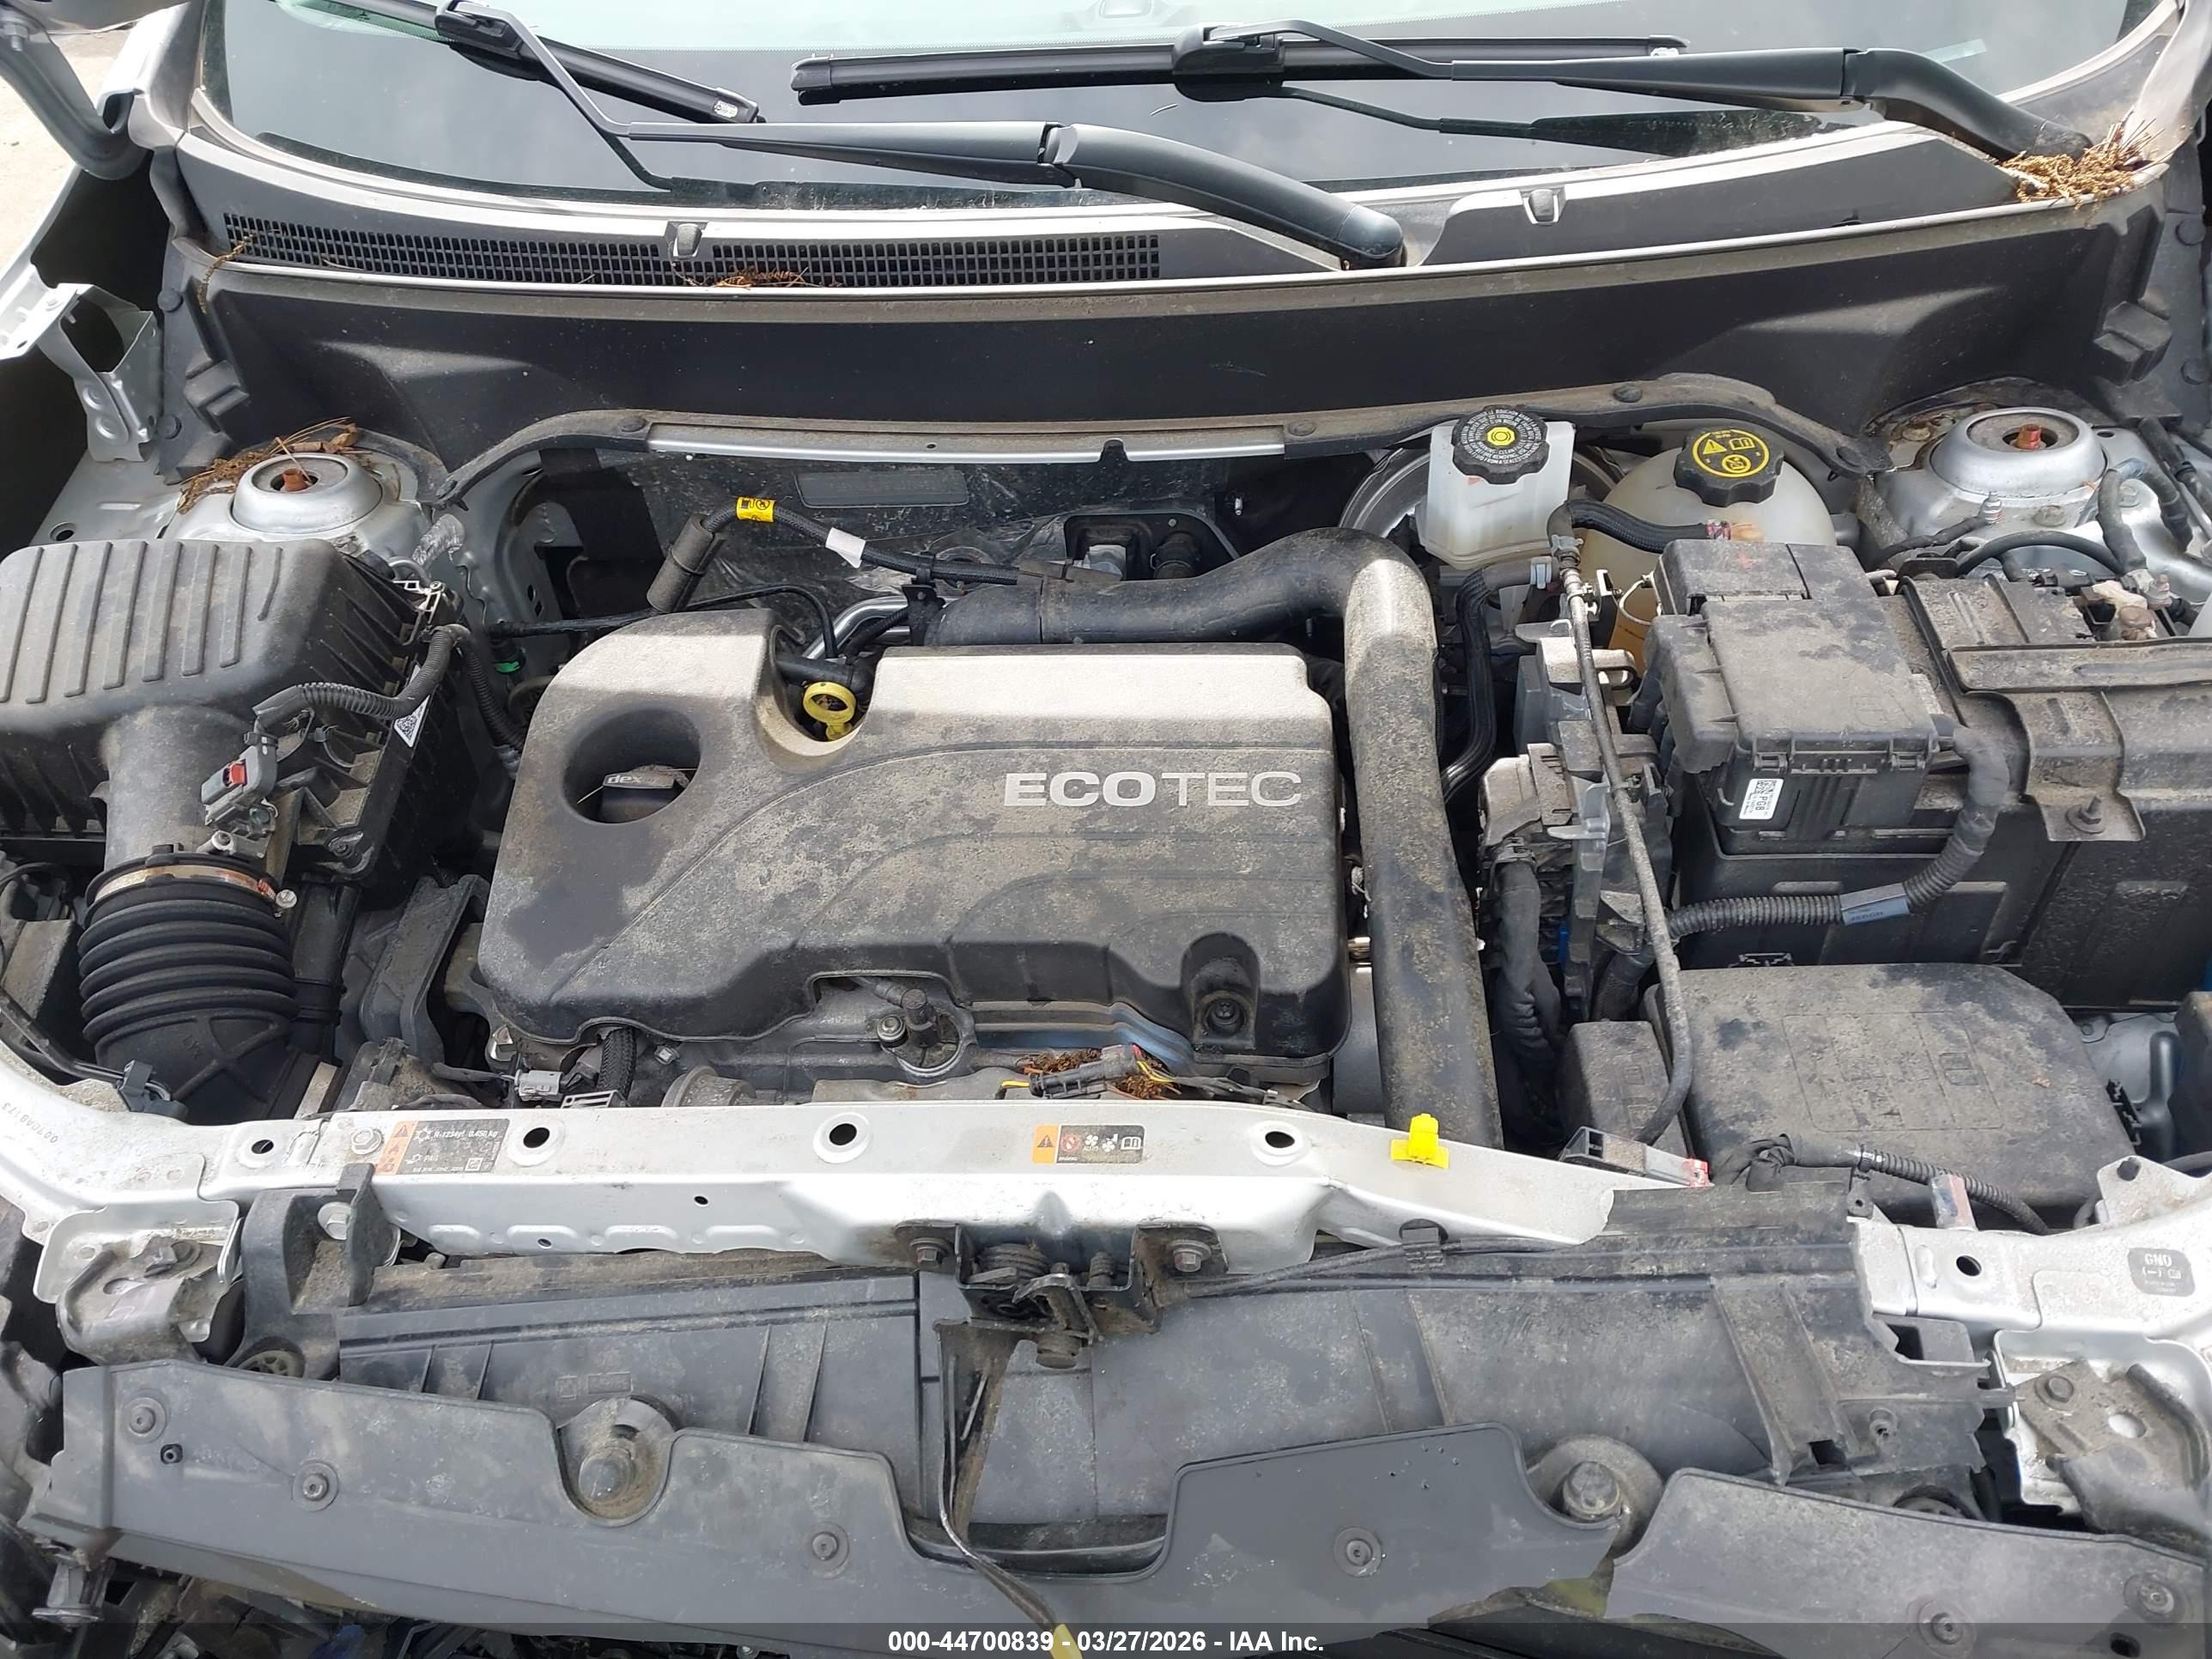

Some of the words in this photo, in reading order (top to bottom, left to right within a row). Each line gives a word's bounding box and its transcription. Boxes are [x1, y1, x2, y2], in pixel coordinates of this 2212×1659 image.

[1003, 771, 1303, 807] ECOTEC
[1755, 795, 1768, 811] PGB
[2144, 1253, 2172, 1267] GND
